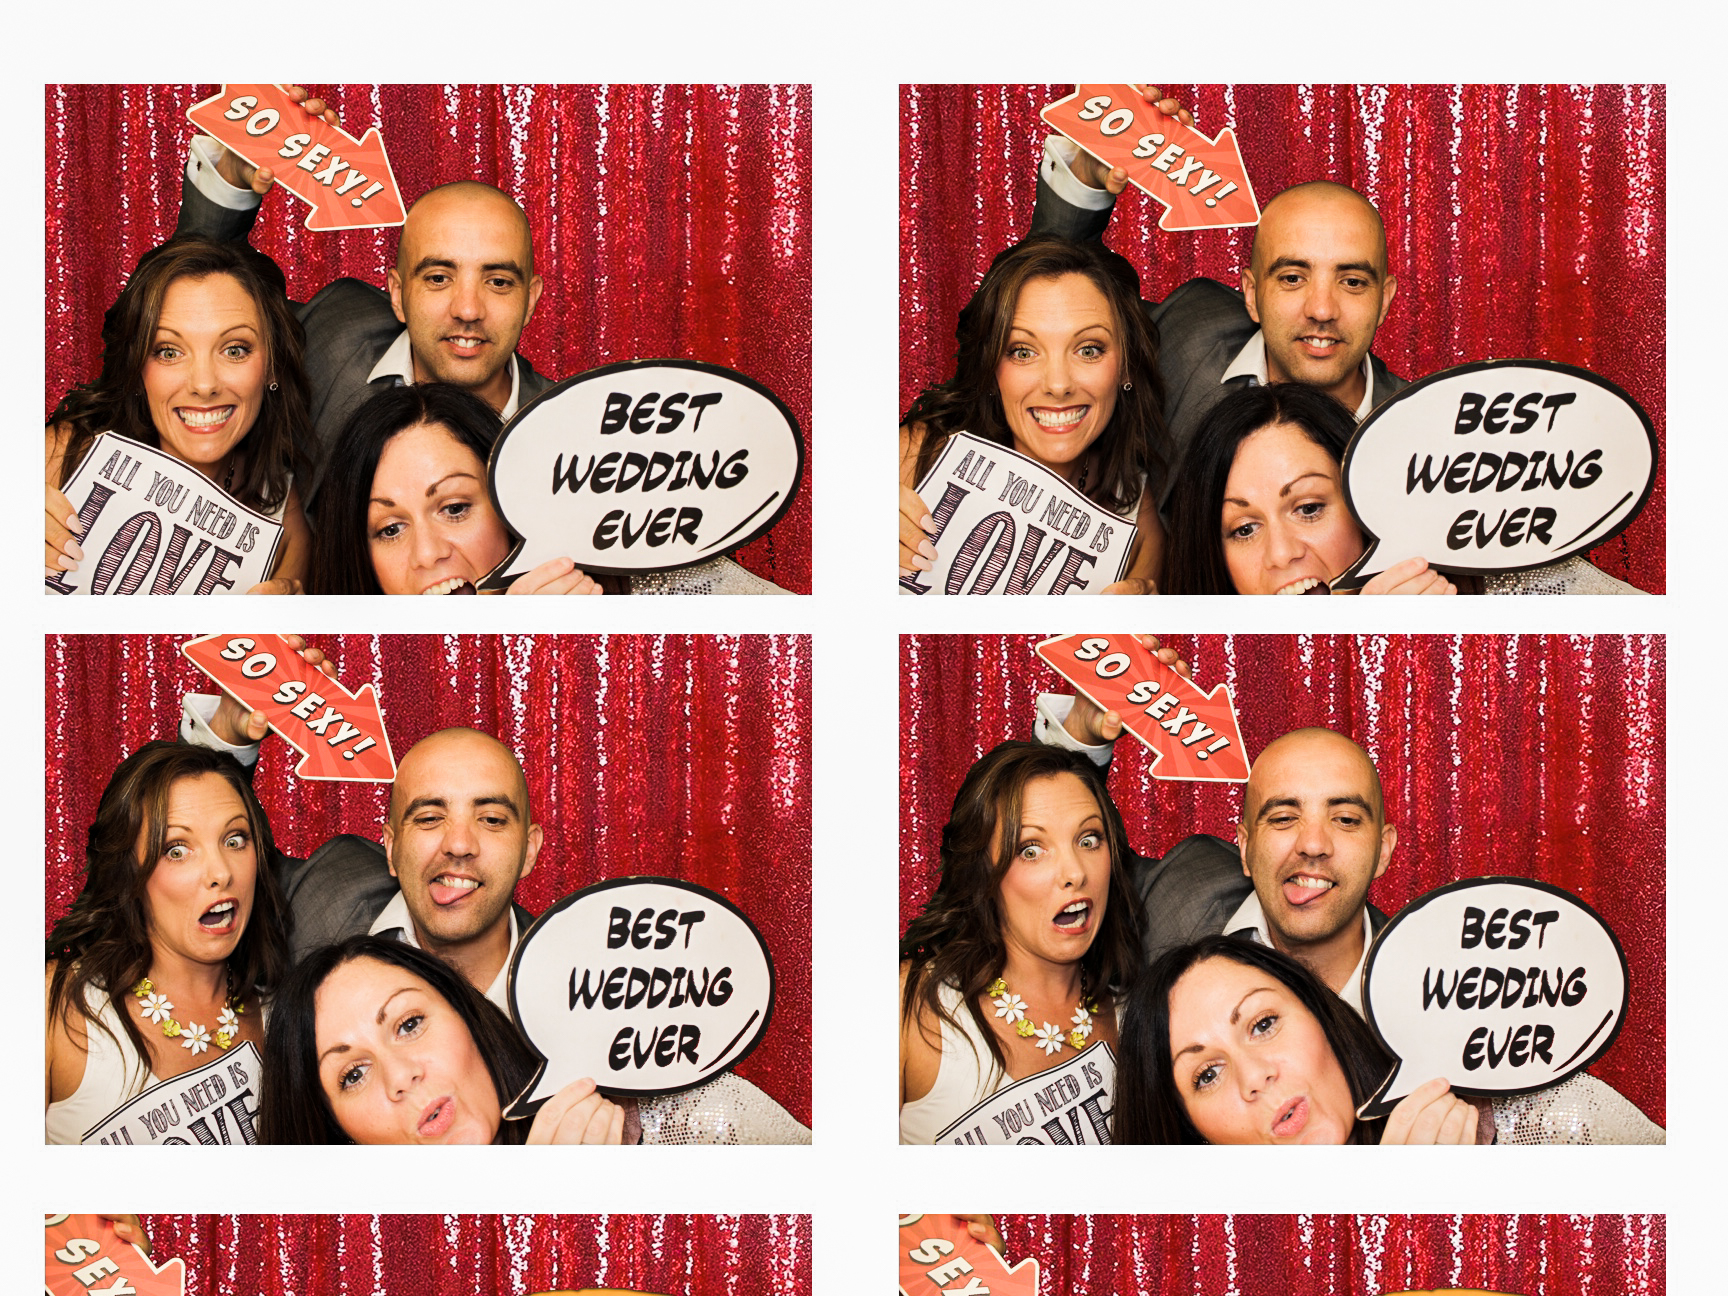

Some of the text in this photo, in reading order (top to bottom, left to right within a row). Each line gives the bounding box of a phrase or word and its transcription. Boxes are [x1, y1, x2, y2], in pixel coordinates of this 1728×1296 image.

[223, 95, 385, 208] SO SEXY!
[1077, 95, 1239, 208] SO SEXY!
[600, 392, 723, 435] BEST
[1454, 392, 1577, 435] BEST
[552, 449, 749, 495] WEDDING
[1406, 449, 1603, 495] WEDDING
[98, 449, 261, 553] ALL YOU NEED IS
[952, 449, 1115, 553] ALL YOU NEED IS
[592, 506, 703, 551] EVER
[1446, 506, 1557, 551] EVER
[220, 637, 377, 761] SO SEXY!
[1074, 637, 1231, 761] SO SEXY!
[607, 906, 706, 950] BEST
[1461, 906, 1560, 950] BEST
[568, 966, 734, 1011] WEDDING
[1422, 966, 1588, 1011] WEDDING
[608, 1024, 701, 1072] EVER
[1462, 1024, 1555, 1072] EVER
[138, 1099, 181, 1140] YOU
[180, 1073, 227, 1117] NEED
[227, 1061, 249, 1090] IS
[992, 1099, 1035, 1140] YOU
[1034, 1073, 1081, 1117] NEED
[1081, 1061, 1103, 1090] IS
